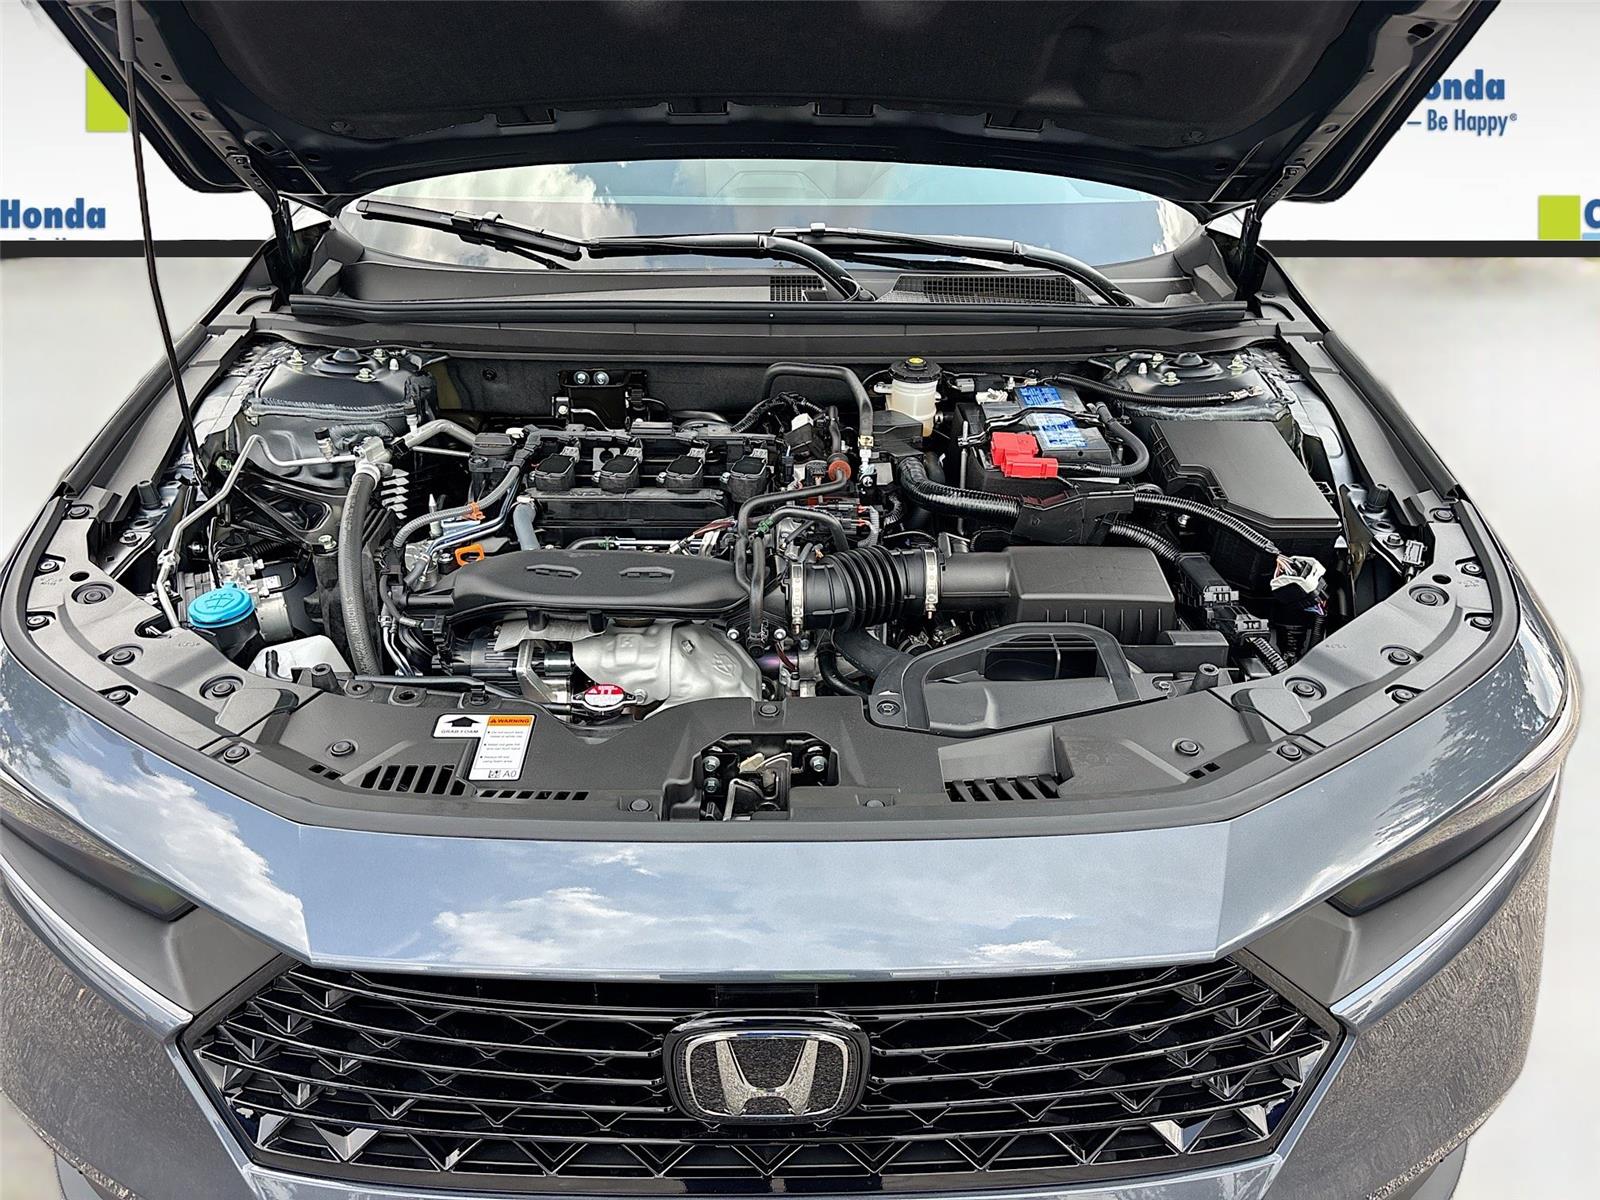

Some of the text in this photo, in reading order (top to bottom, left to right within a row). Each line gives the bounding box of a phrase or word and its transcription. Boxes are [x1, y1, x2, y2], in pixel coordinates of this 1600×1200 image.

[1423, 69, 1505, 100] onda
[1427, 109, 1448, 131] Be
[0, 197, 106, 229] Honda
